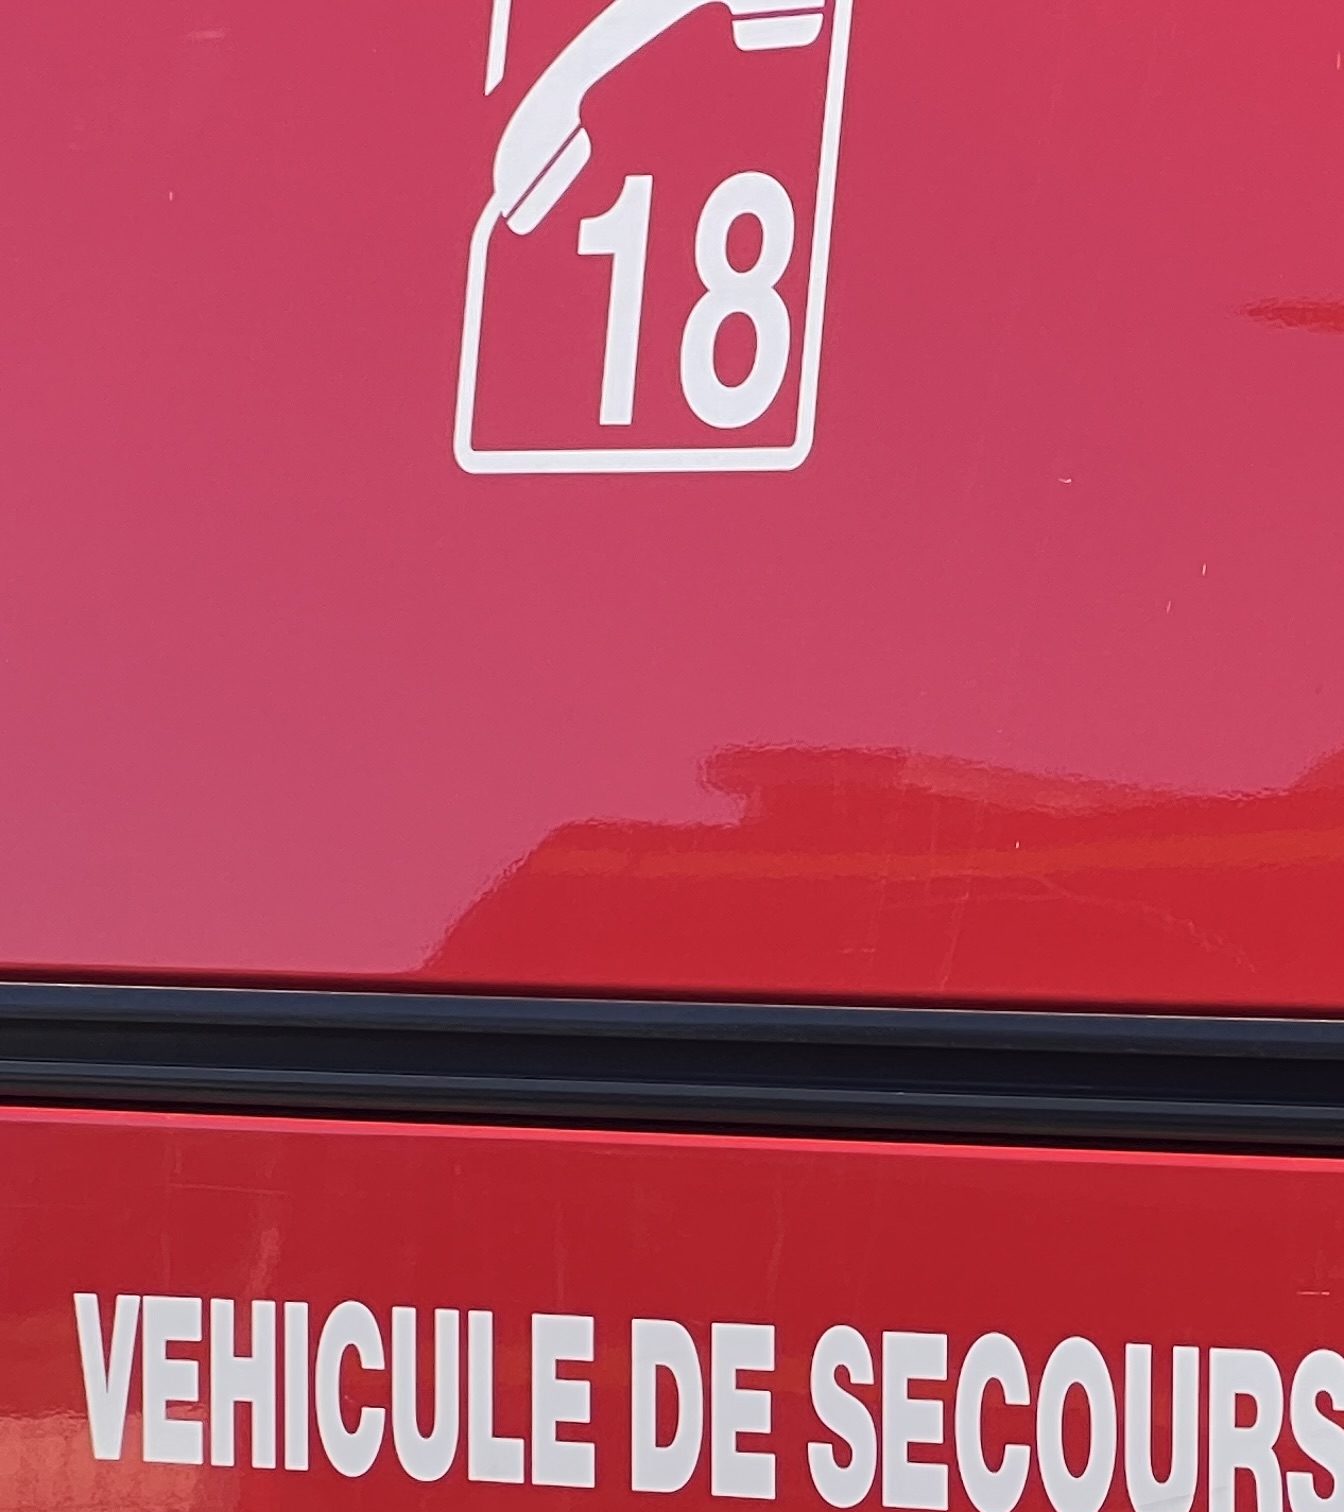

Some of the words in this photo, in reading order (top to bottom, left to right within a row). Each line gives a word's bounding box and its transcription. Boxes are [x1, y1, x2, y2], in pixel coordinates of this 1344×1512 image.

[577, 171, 795, 429] 18
[73, 1293, 596, 1489] VEHICULE
[631, 1318, 776, 1500] DE
